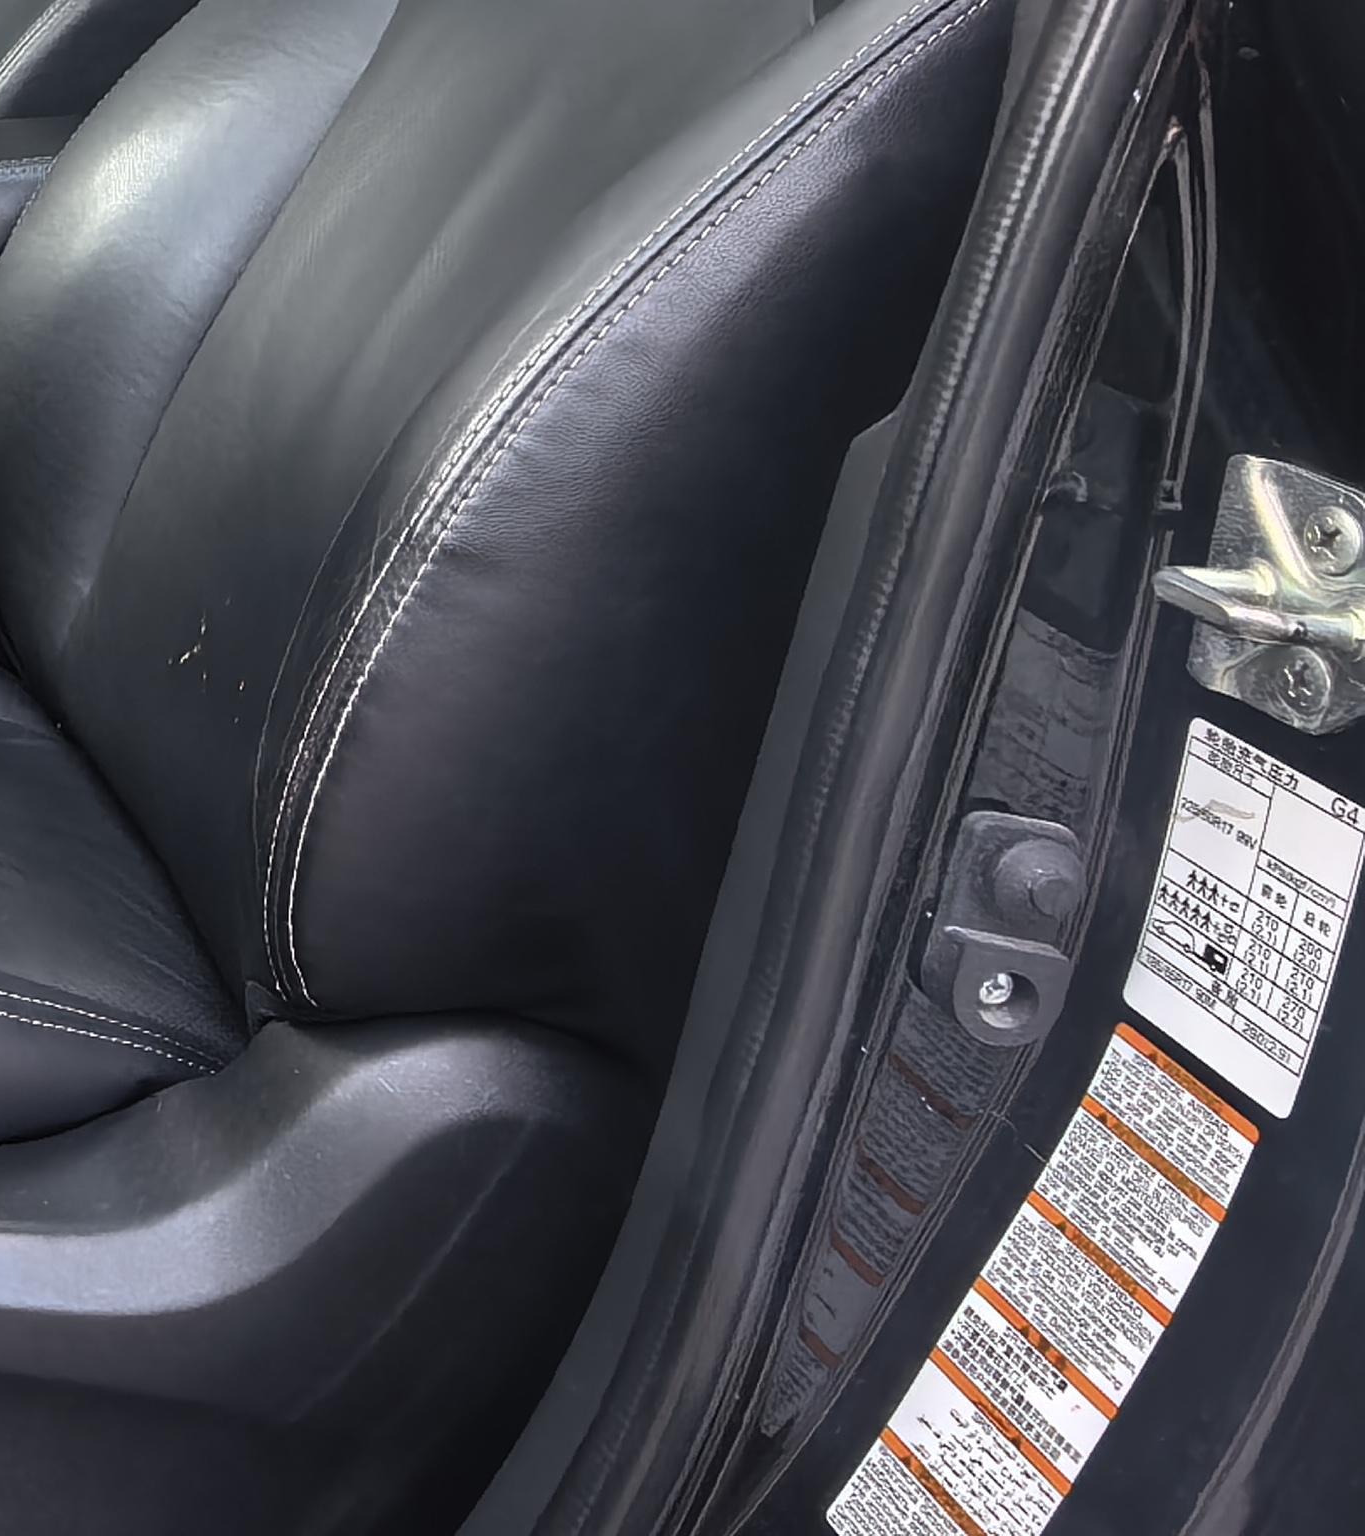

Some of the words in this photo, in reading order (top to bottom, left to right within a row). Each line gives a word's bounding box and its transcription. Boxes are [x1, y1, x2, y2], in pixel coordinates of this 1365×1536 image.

[1331, 797, 1360, 825] G4
[1255, 910, 1279, 932] 210
[1240, 968, 1264, 990] 210
[1281, 996, 1306, 1019] 270
